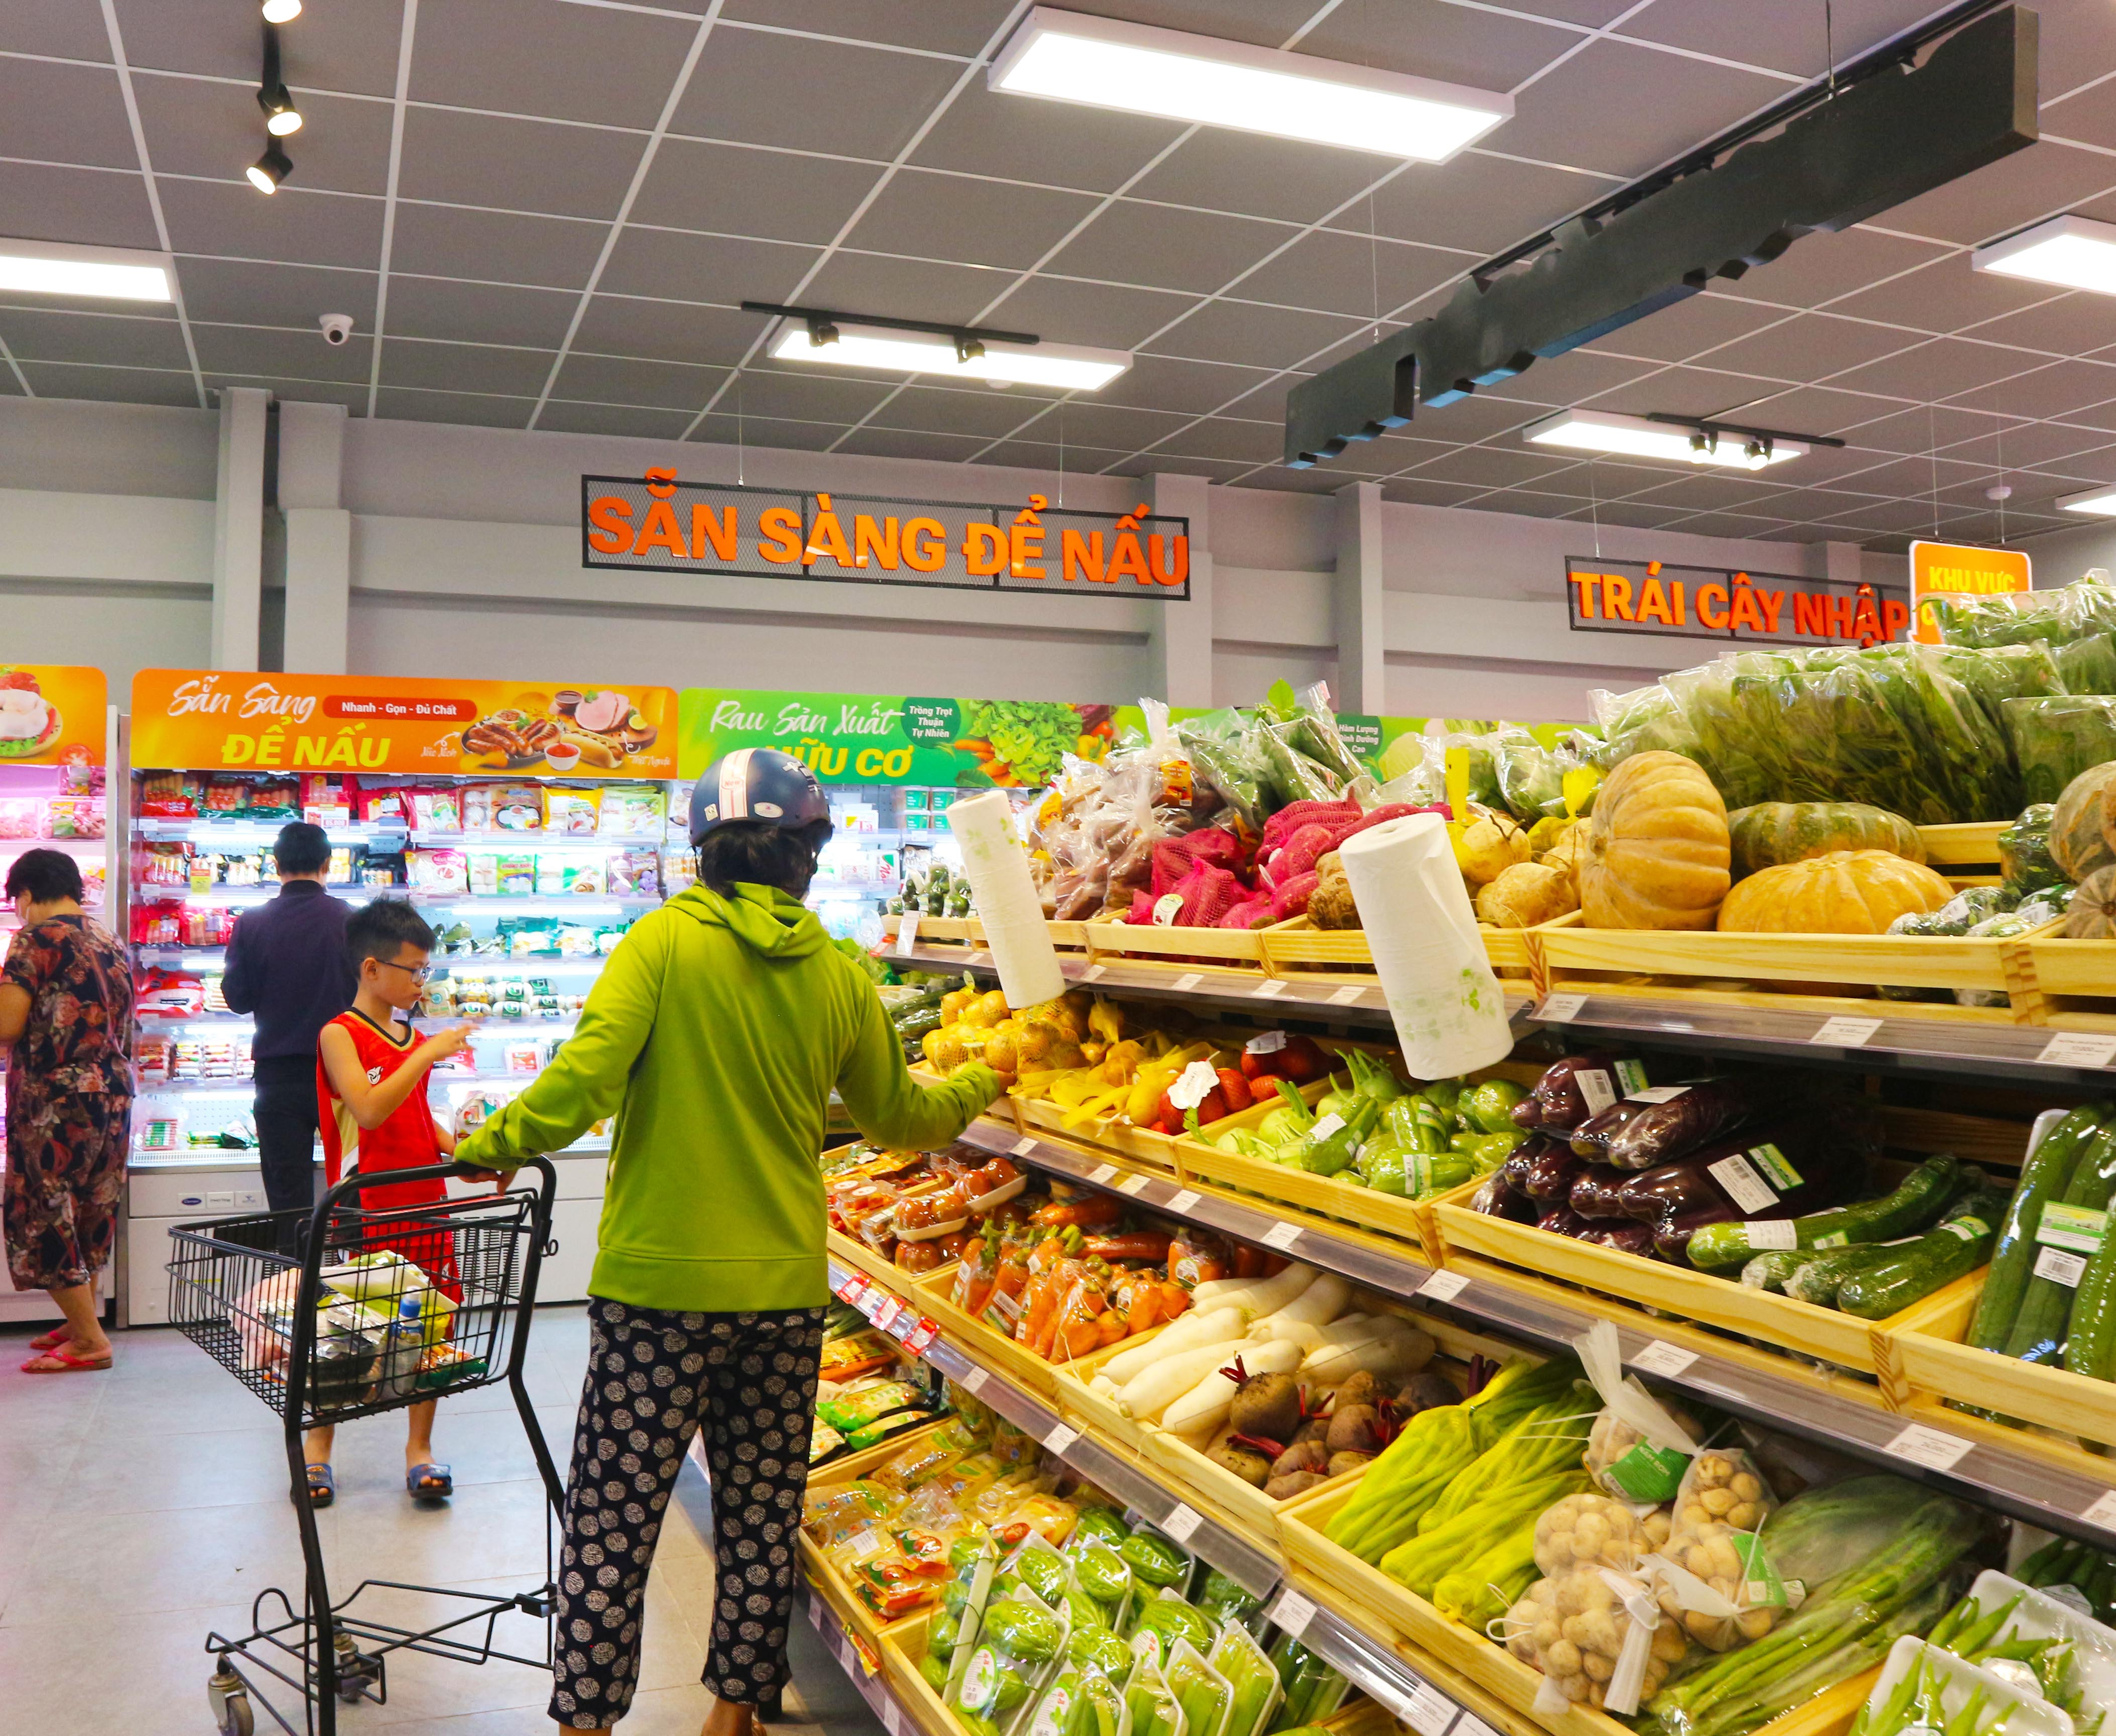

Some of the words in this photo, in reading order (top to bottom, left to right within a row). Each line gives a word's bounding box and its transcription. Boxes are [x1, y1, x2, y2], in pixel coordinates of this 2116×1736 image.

[588, 467, 737, 561] SẴN
[758, 493, 947, 573] SÀNG
[962, 494, 1047, 579] ĐỂ
[1063, 502, 1189, 586] NẤU
[1929, 566, 1970, 592] KHU
[1568, 561, 1684, 626] TRÁI
[1696, 572, 1785, 633] CÂY
[1793, 583, 1909, 648] NHẬP
[168, 675, 231, 716] Sẵn
[239, 682, 316, 723] Sàng
[342, 702, 376, 713] Nhanh
[385, 703, 406, 715] Gọn
[416, 703, 430, 715] Đủ
[433, 704, 457, 715] Chất
[909, 705, 933, 717] Trồng
[935, 706, 953, 717] Trọt
[710, 700, 769, 733] Rau
[773, 702, 827, 735] Sản
[832, 702, 905, 735] Xuất
[912, 727, 924, 738] Tự
[924, 728, 950, 737] Nhiên
[918, 717, 944, 728] Thuận
[221, 716, 293, 765] ĐỂ
[293, 722, 391, 768] NẤU
[1352, 744, 1366, 753] Cao
[766, 737, 849, 776] ỮU
[856, 745, 914, 778] CƠ
